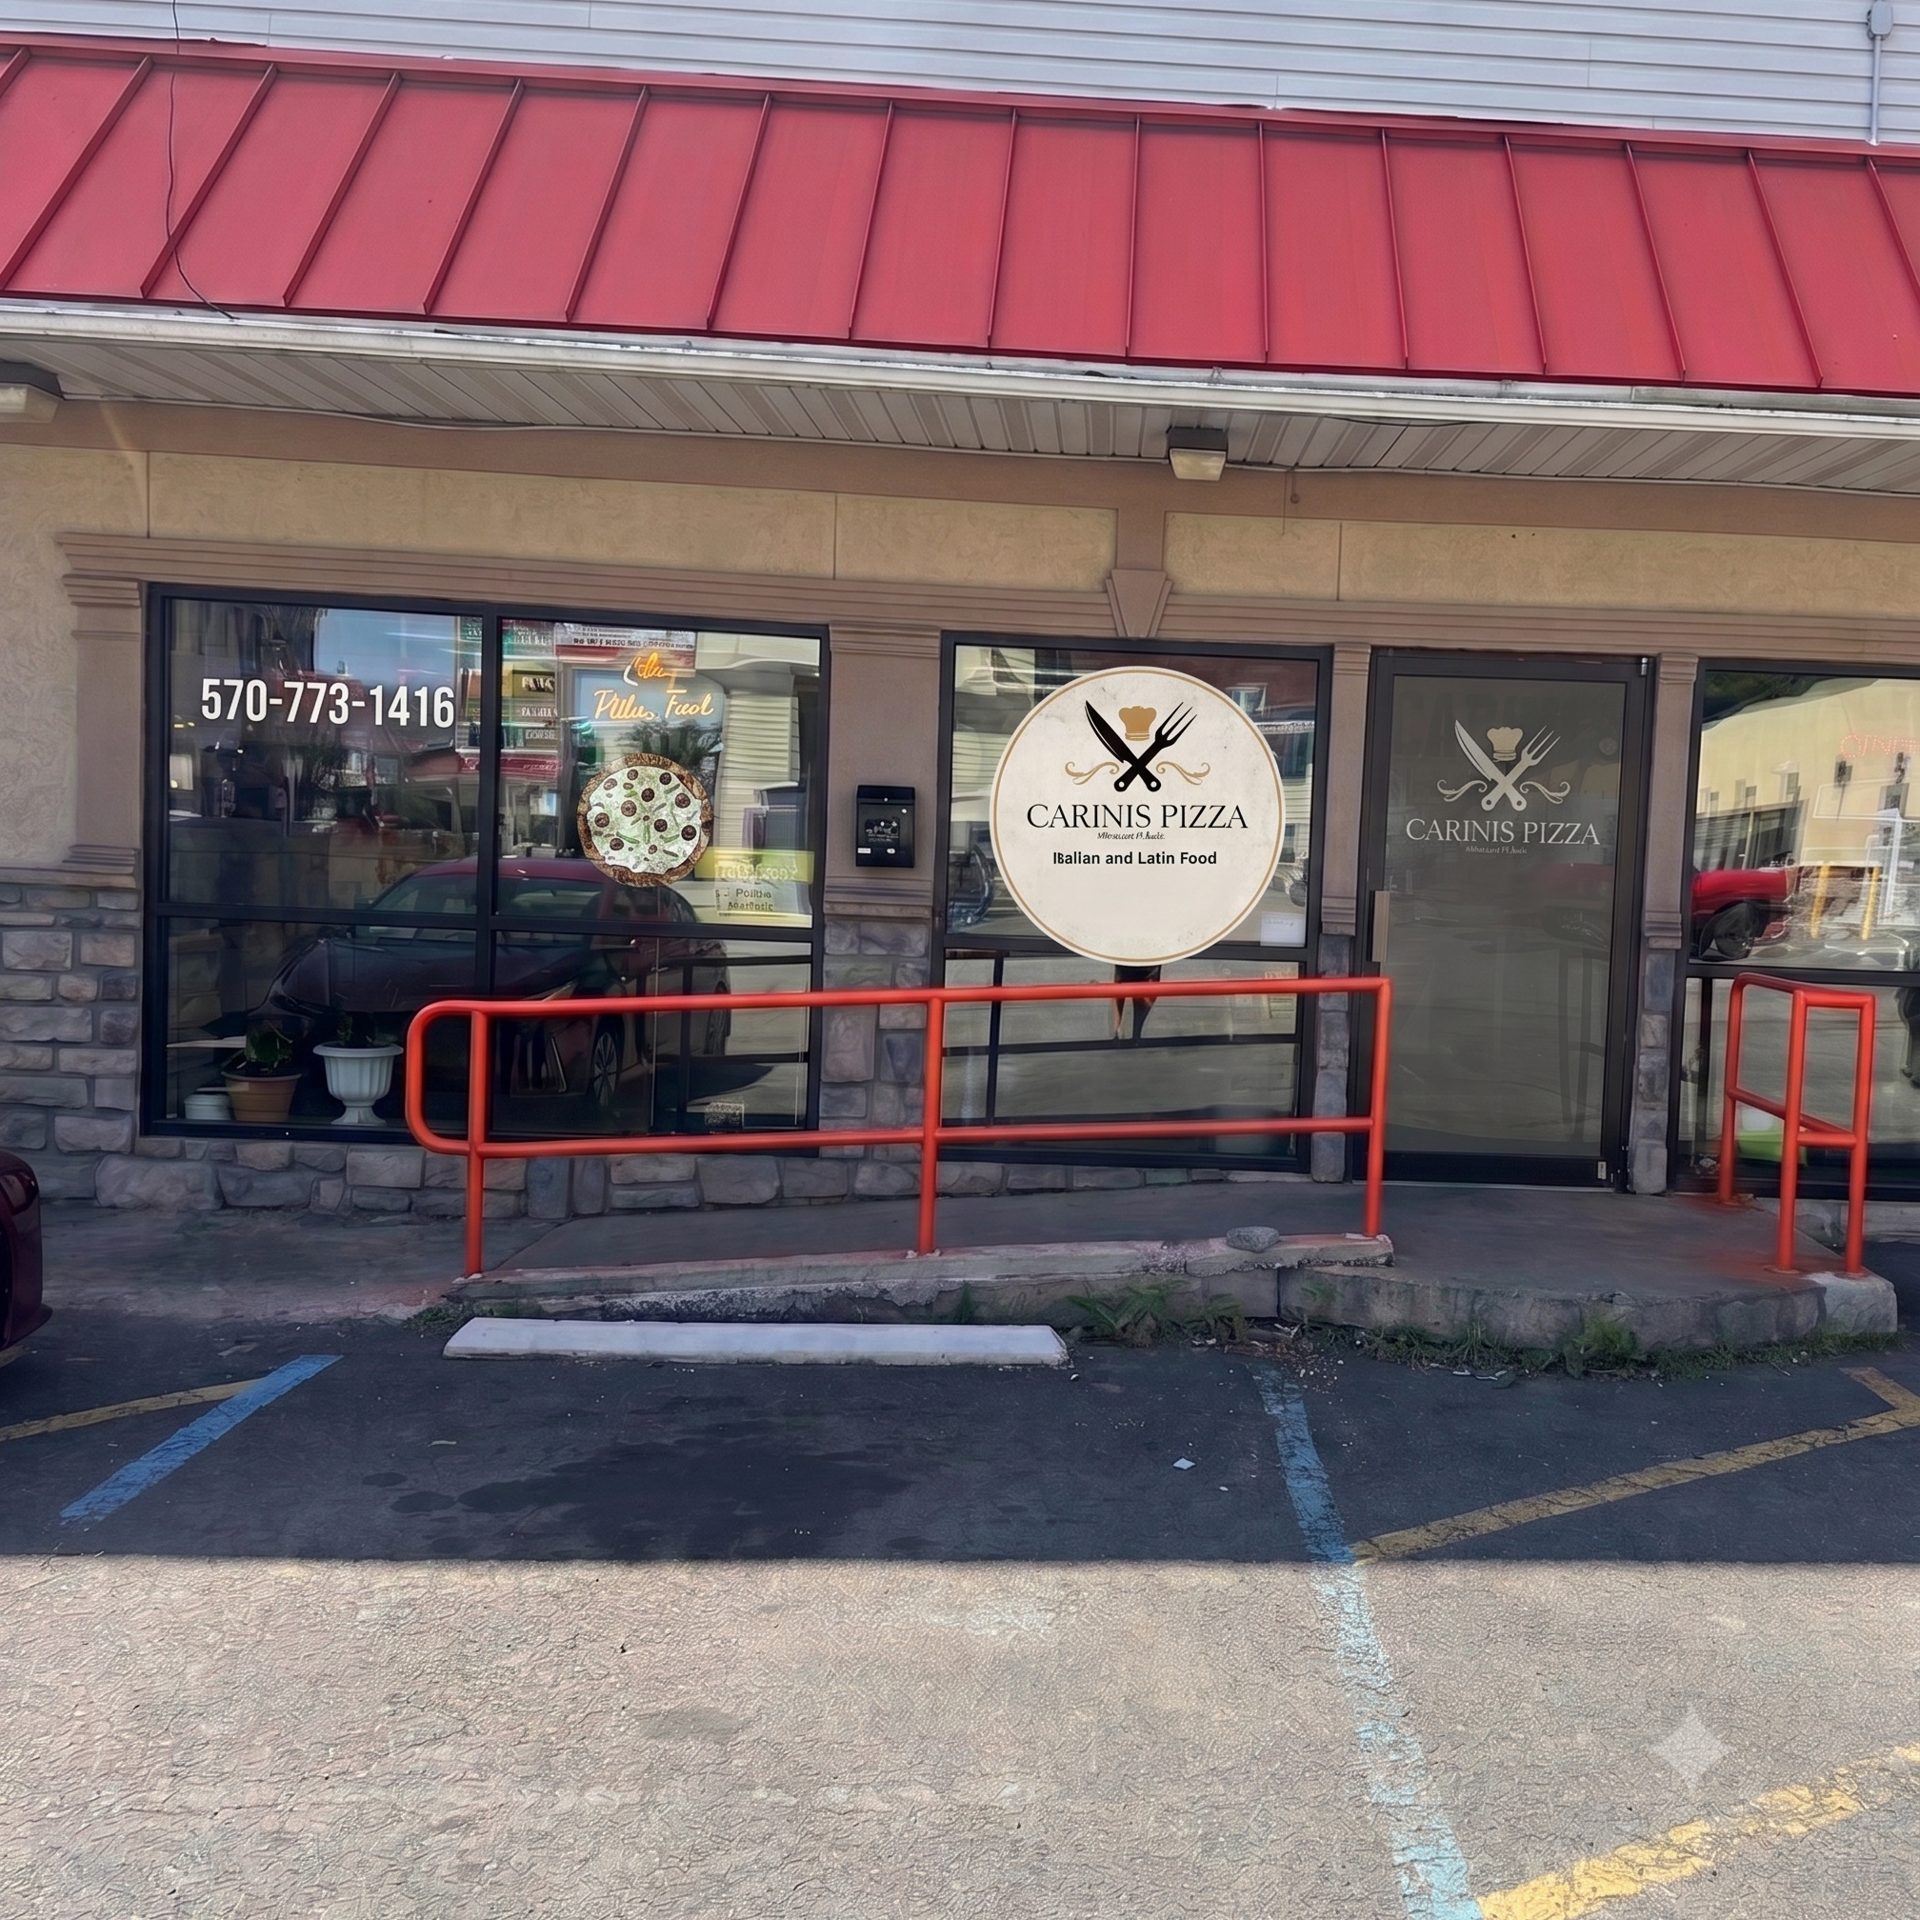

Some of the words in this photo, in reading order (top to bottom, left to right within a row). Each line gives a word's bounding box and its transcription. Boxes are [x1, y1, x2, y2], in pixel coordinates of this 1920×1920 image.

[201, 678, 455, 728] 570-773-1416
[1027, 803, 1151, 829] CARINIS
[1161, 804, 1248, 829] PIZZA
[1406, 818, 1514, 843] CARINIS
[1523, 821, 1601, 845] PIZZA
[1105, 851, 1133, 864] and
[1138, 851, 1175, 864] Latin
[1180, 851, 1217, 864] Food
